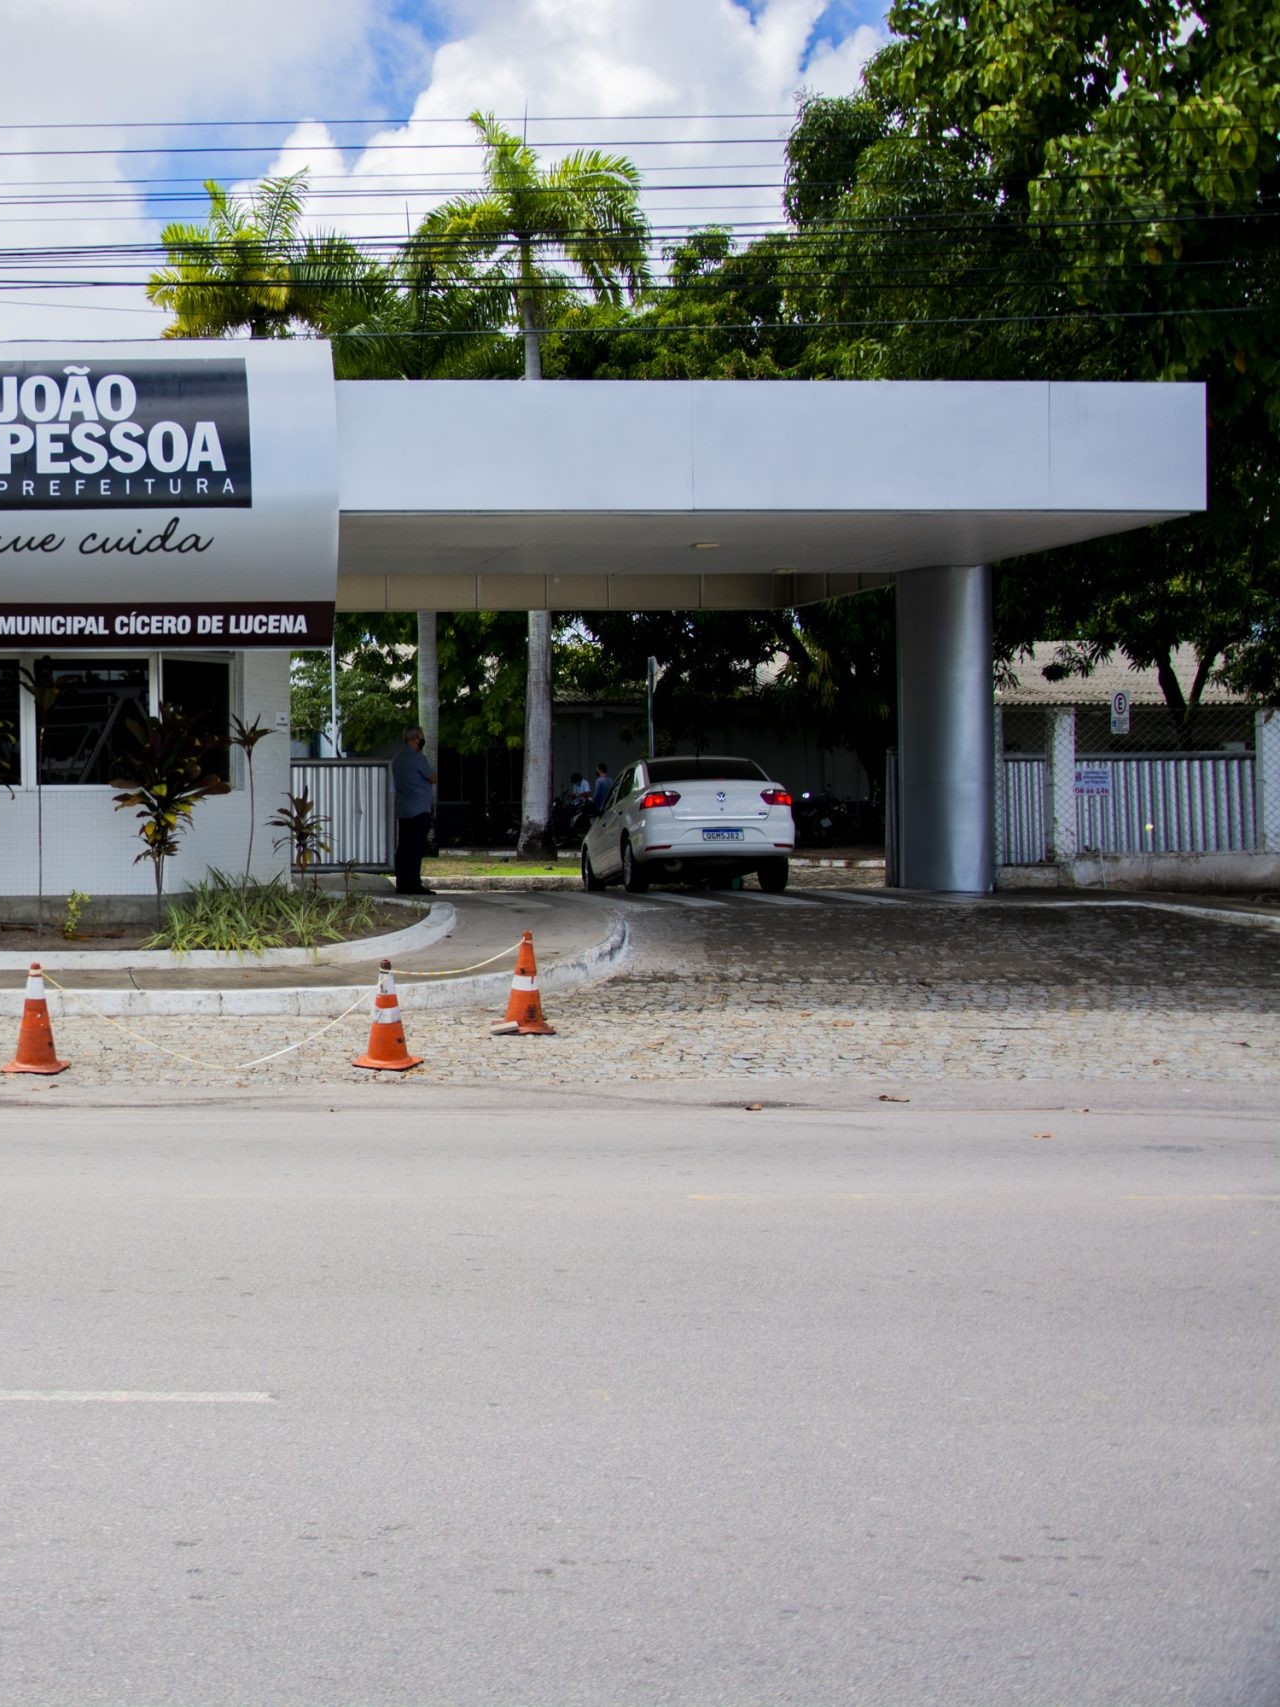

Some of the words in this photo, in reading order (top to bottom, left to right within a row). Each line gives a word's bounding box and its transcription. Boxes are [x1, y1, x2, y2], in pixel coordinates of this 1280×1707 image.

[78, 516, 214, 556] cuida
[114, 611, 191, 635] CÍCERO
[197, 615, 223, 633] DE
[229, 614, 308, 634] LUCENA
[1118, 697, 1123, 710] E
